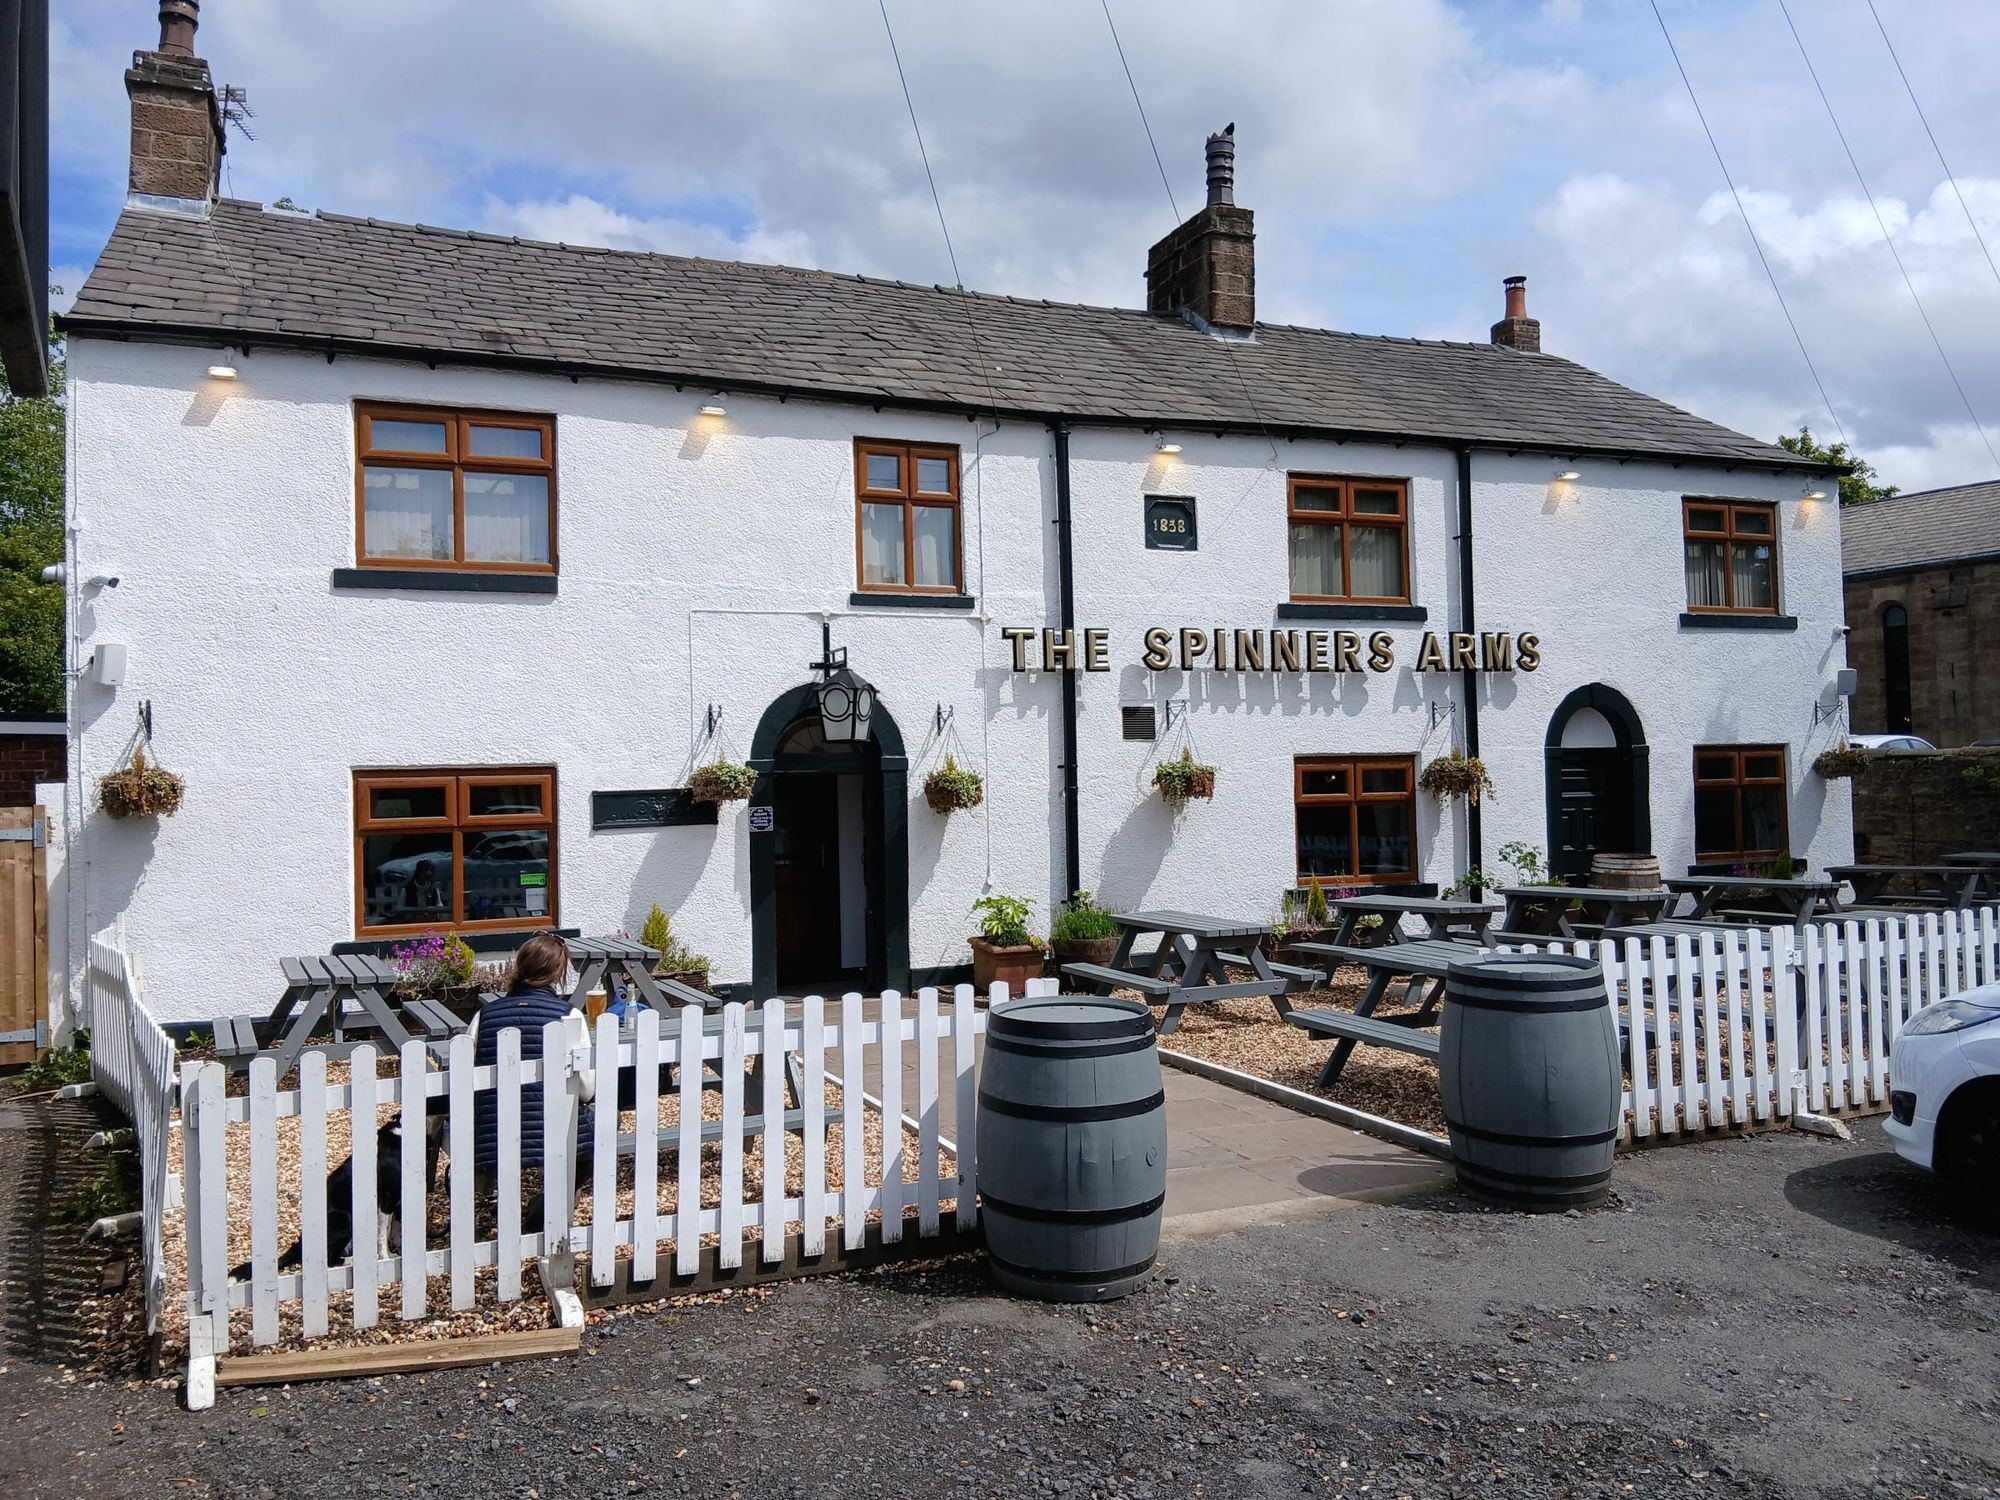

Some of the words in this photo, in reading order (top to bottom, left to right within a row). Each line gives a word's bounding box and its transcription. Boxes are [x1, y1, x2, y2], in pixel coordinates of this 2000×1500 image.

[1153, 518, 1186, 533] 1838
[1002, 627, 1110, 672] THE
[1143, 627, 1395, 672] SPINNERS
[1415, 631, 1541, 672] ARMS
